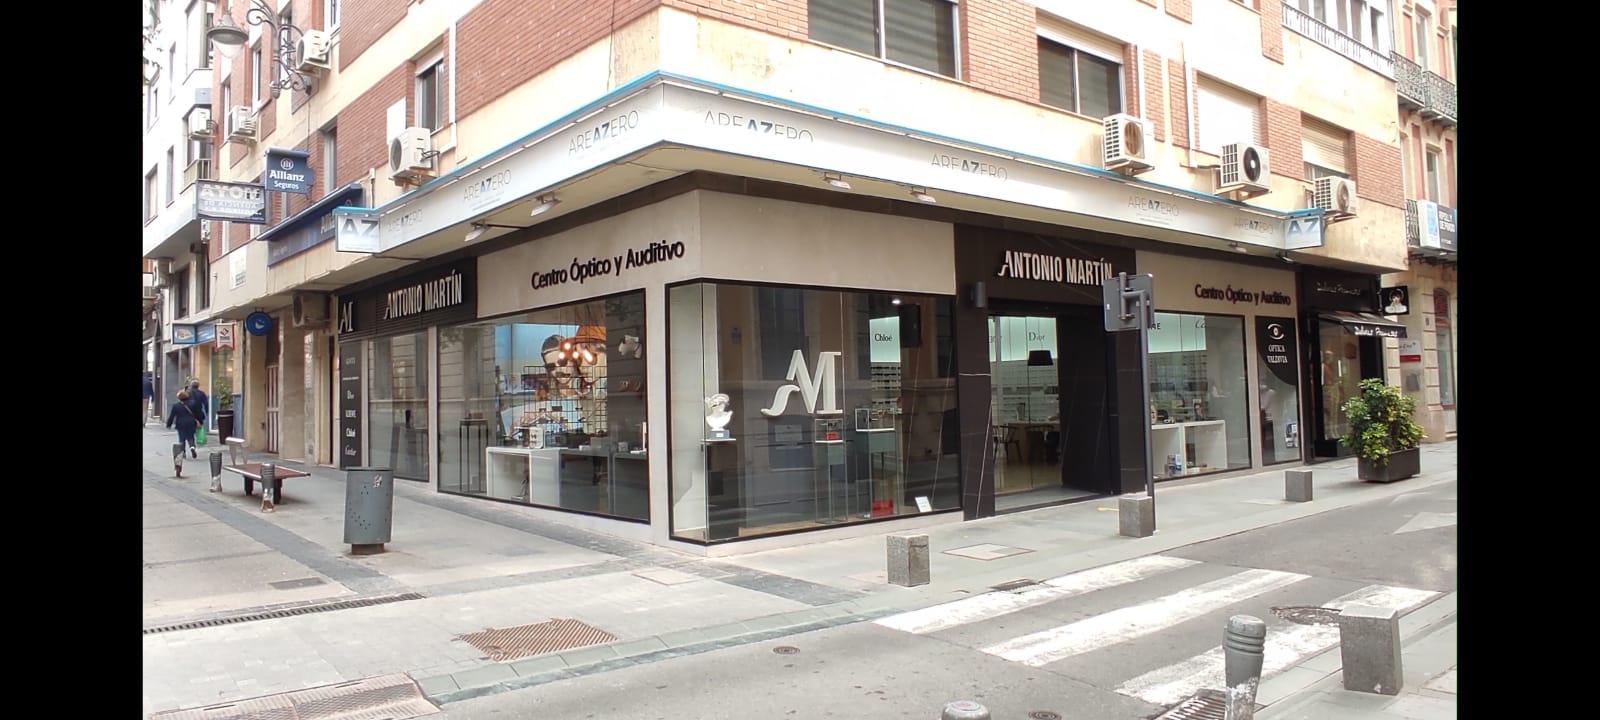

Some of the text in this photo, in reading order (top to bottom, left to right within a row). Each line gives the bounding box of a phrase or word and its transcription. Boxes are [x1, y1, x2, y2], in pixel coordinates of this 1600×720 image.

[568, 110, 639, 155] AREAZERO
[269, 169, 305, 182] Allianz
[274, 180, 299, 190] Seguros
[463, 169, 512, 201] AREAZERO
[341, 218, 379, 237] AZ
[1288, 217, 1319, 234] AZ
[531, 239, 685, 290] Centro Óptico y Auditivo
[997, 250, 1112, 286] ANTONIO MARTÍN
[383, 268, 462, 320] ANTONIO MARTÍN
[1194, 283, 1292, 306] Centro Óptico y Auditivo
